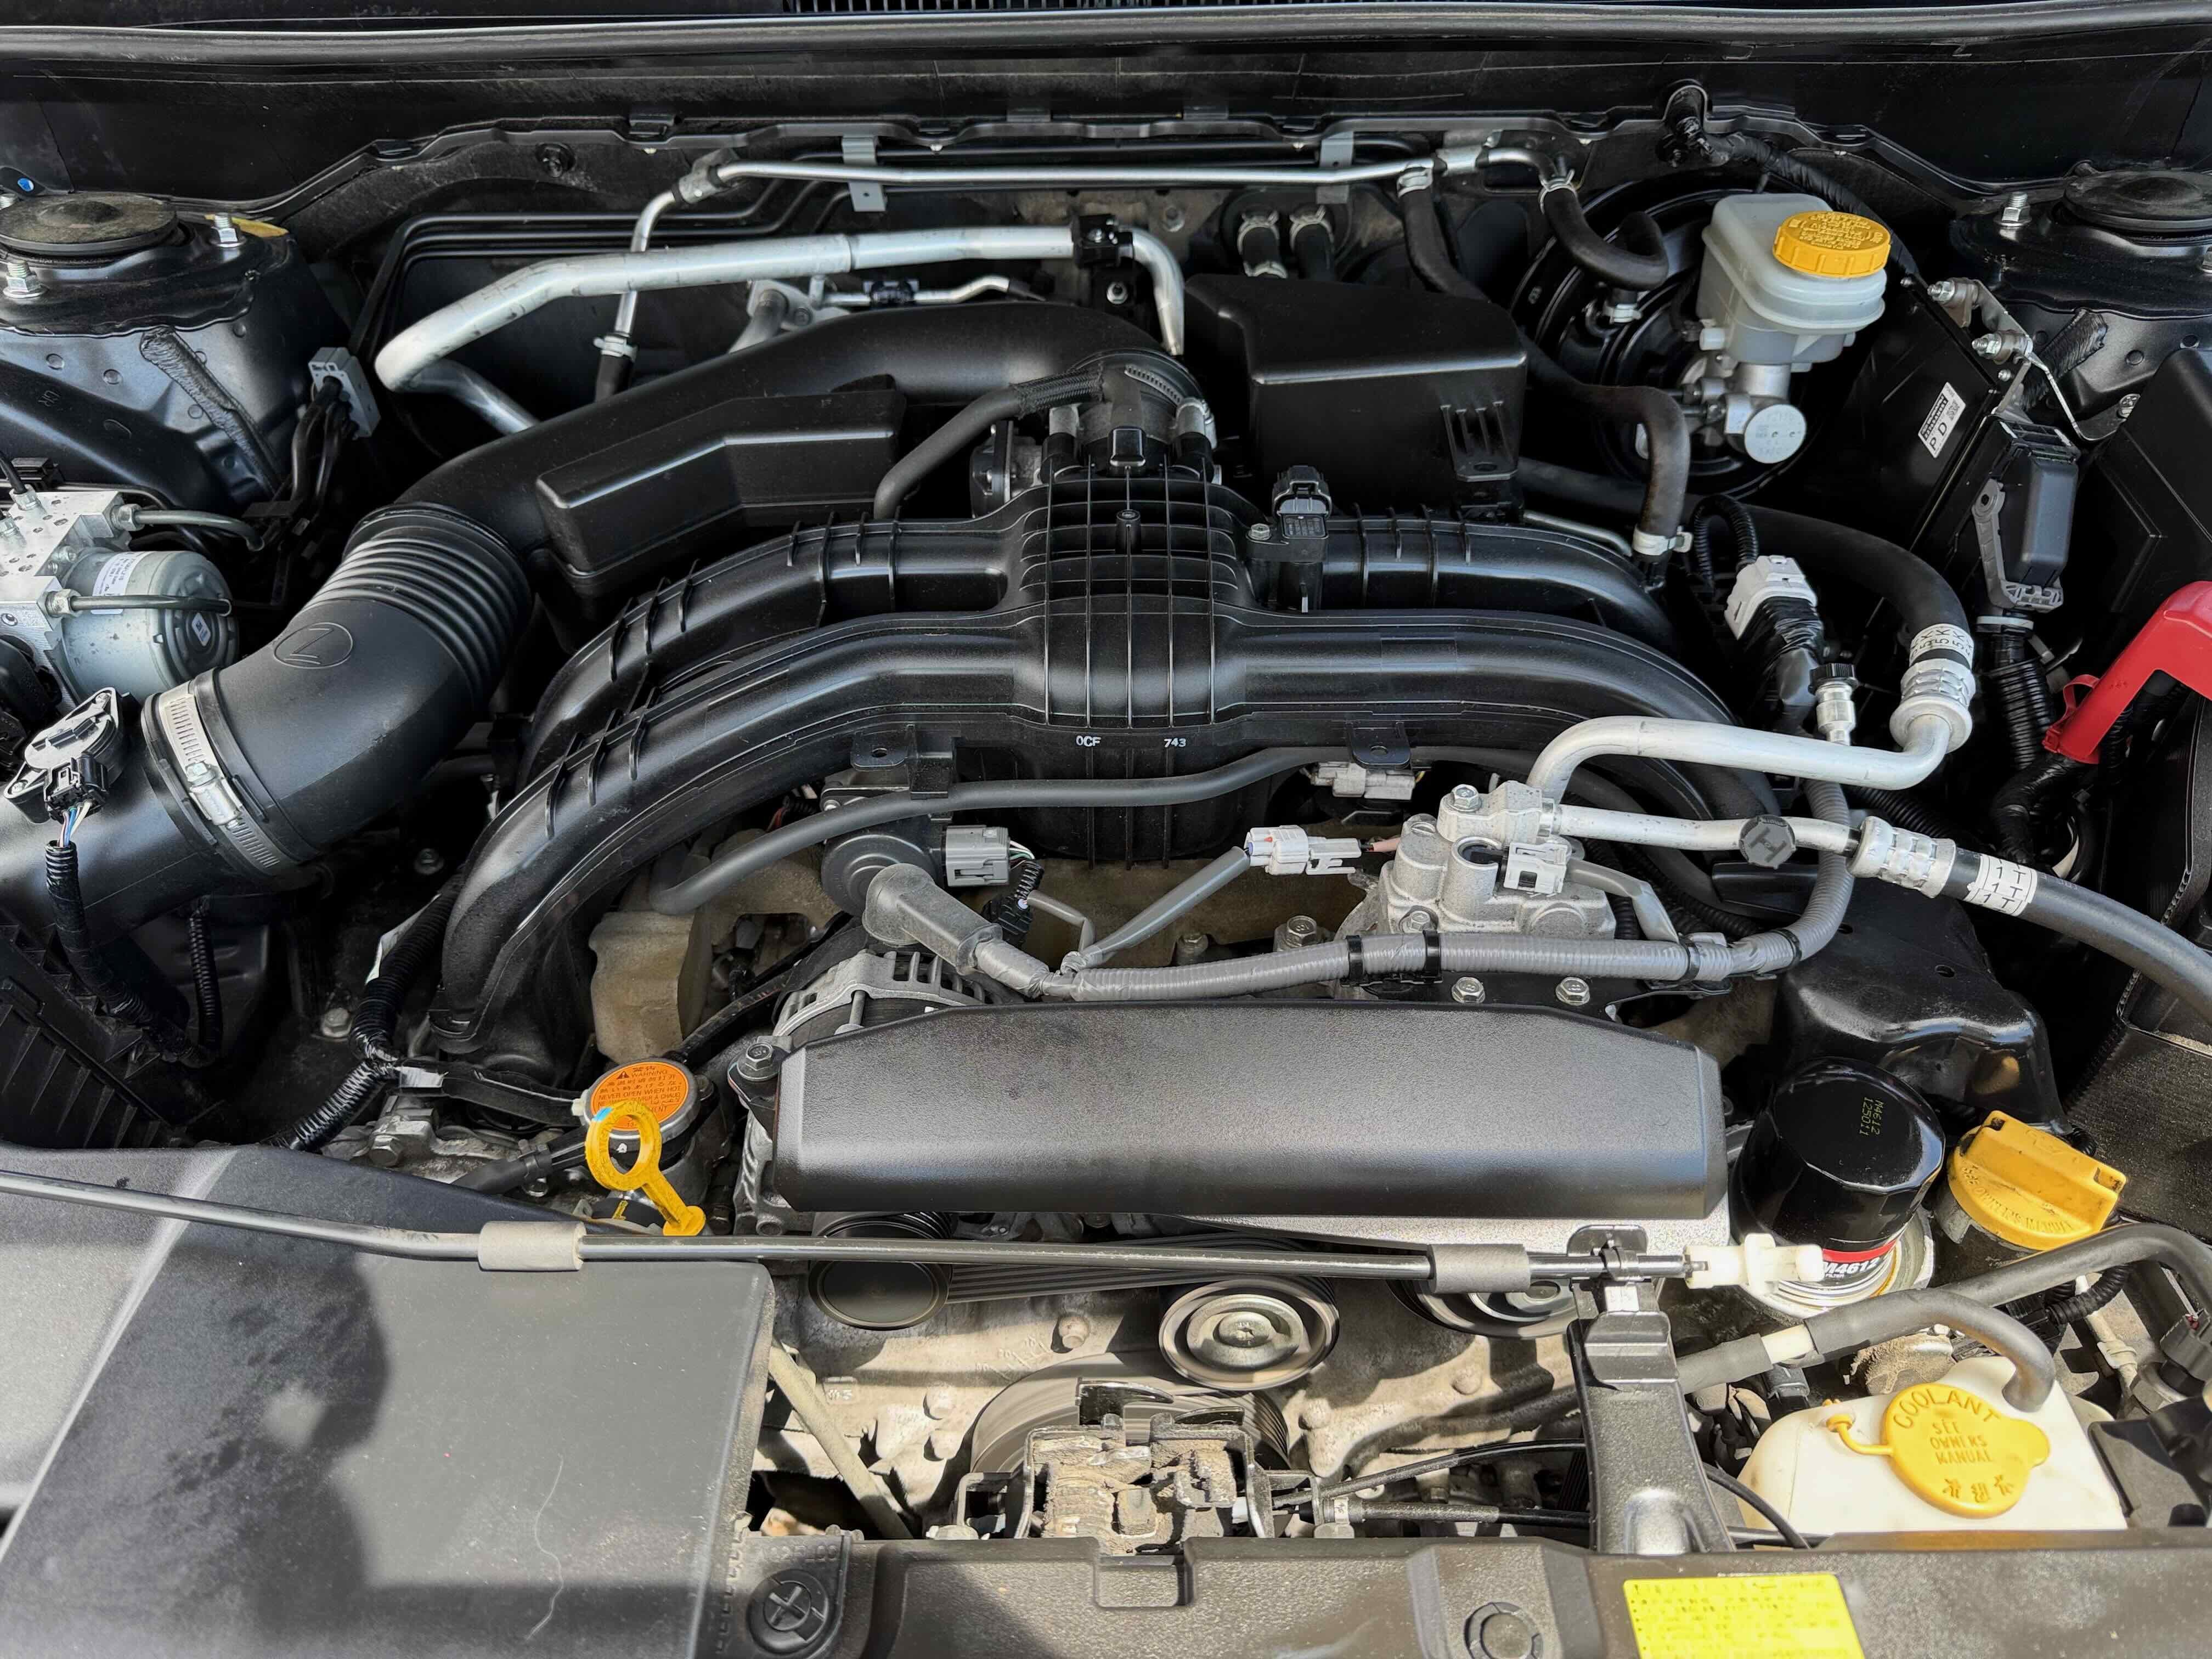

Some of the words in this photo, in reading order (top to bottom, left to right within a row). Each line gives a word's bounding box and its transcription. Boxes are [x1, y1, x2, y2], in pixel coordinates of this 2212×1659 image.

[1935, 629, 1950, 644] 5K
[1164, 738, 1187, 748] 743
[599, 1092, 621, 1101] NEVER
[1893, 1388, 2002, 1429] COOLANT
[1932, 1419, 1960, 1435] SEE
[1935, 1450, 1994, 1465] MANUAL
